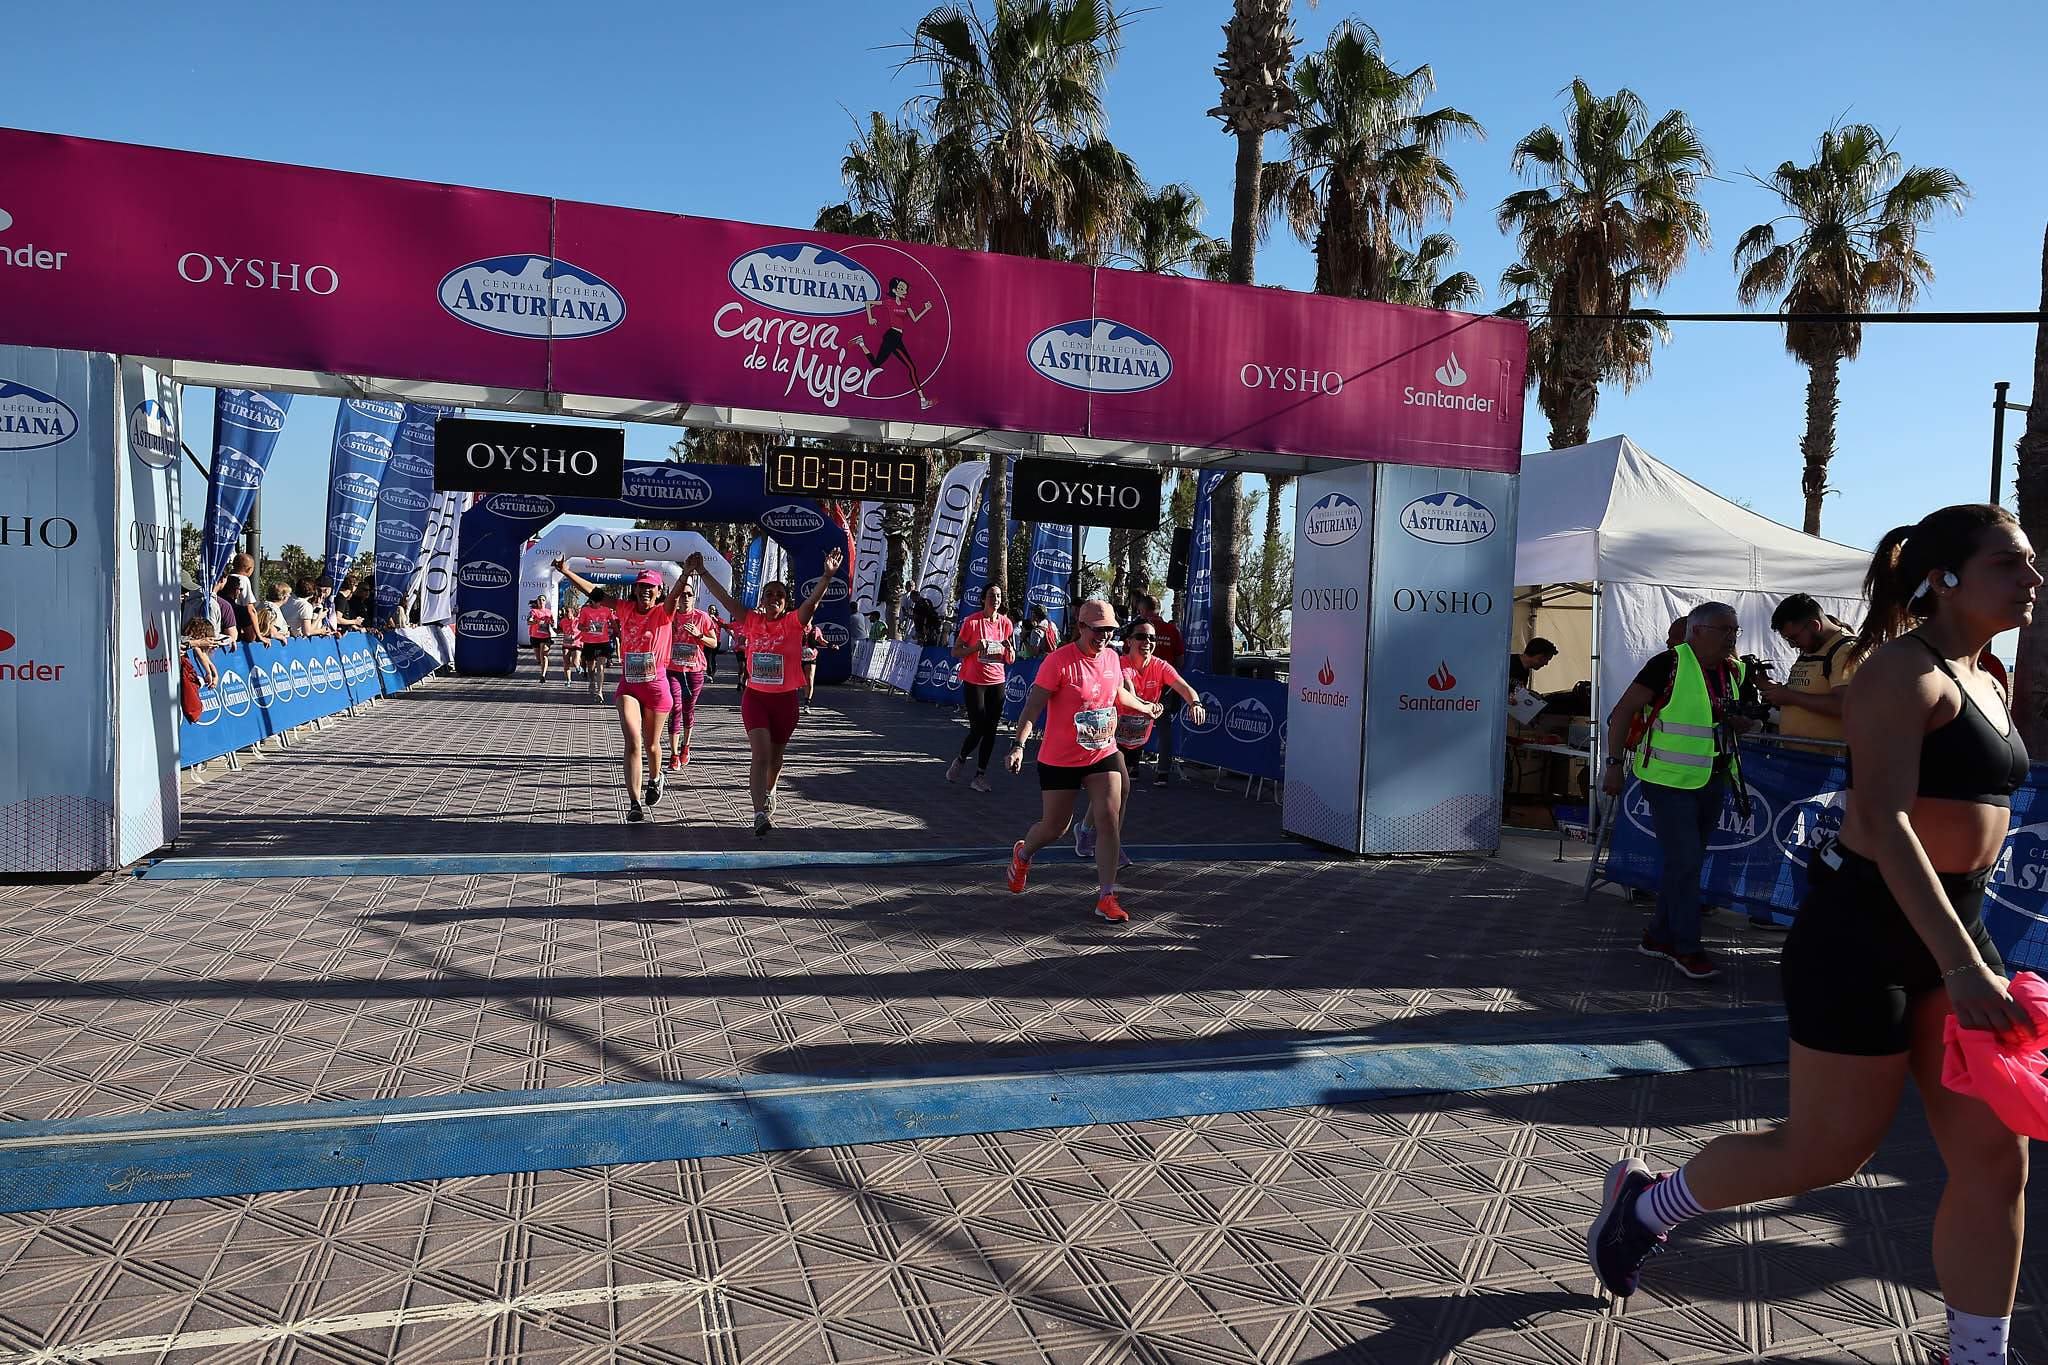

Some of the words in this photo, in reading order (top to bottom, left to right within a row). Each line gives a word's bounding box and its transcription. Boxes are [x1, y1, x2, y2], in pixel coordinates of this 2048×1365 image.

[177, 252, 340, 295] OYSHO
[482, 279, 542, 292] CENTRAL
[740, 262, 869, 303] ASTURIANA
[765, 263, 814, 276] CENTRAL
[817, 269, 866, 282] LECHERA
[452, 278, 612, 323] ASTURIANA
[713, 301, 840, 350] Carrera
[1038, 340, 1162, 379] ASTURIANA
[1111, 345, 1158, 357] LECHERA
[743, 344, 768, 371] de
[772, 346, 789, 373] la
[784, 347, 885, 408] Mujer
[1240, 363, 1344, 396] OYSHO
[1403, 386, 1495, 413] Santander
[466, 442, 598, 476] OYSHO
[777, 454, 916, 494] 00:38:49
[490, 500, 550, 513] ASTURIANA
[1036, 479, 1142, 510] OYSHO
[765, 515, 822, 528] ASTURIANA
[1307, 516, 1358, 535] ASTURIANA
[1406, 509, 1489, 534] ASTURIANA
[130, 520, 175, 554] OYSHO
[586, 532, 671, 553] OYSHO
[919, 483, 972, 610] OYSHO
[461, 571, 508, 584] ASTURIANA
[1300, 587, 1359, 611] OYSHO
[1393, 588, 1493, 616] OYSHO
[458, 619, 506, 633] ASTURIANA
[1300, 687, 1350, 708] Santander
[1398, 694, 1481, 712] Santander
